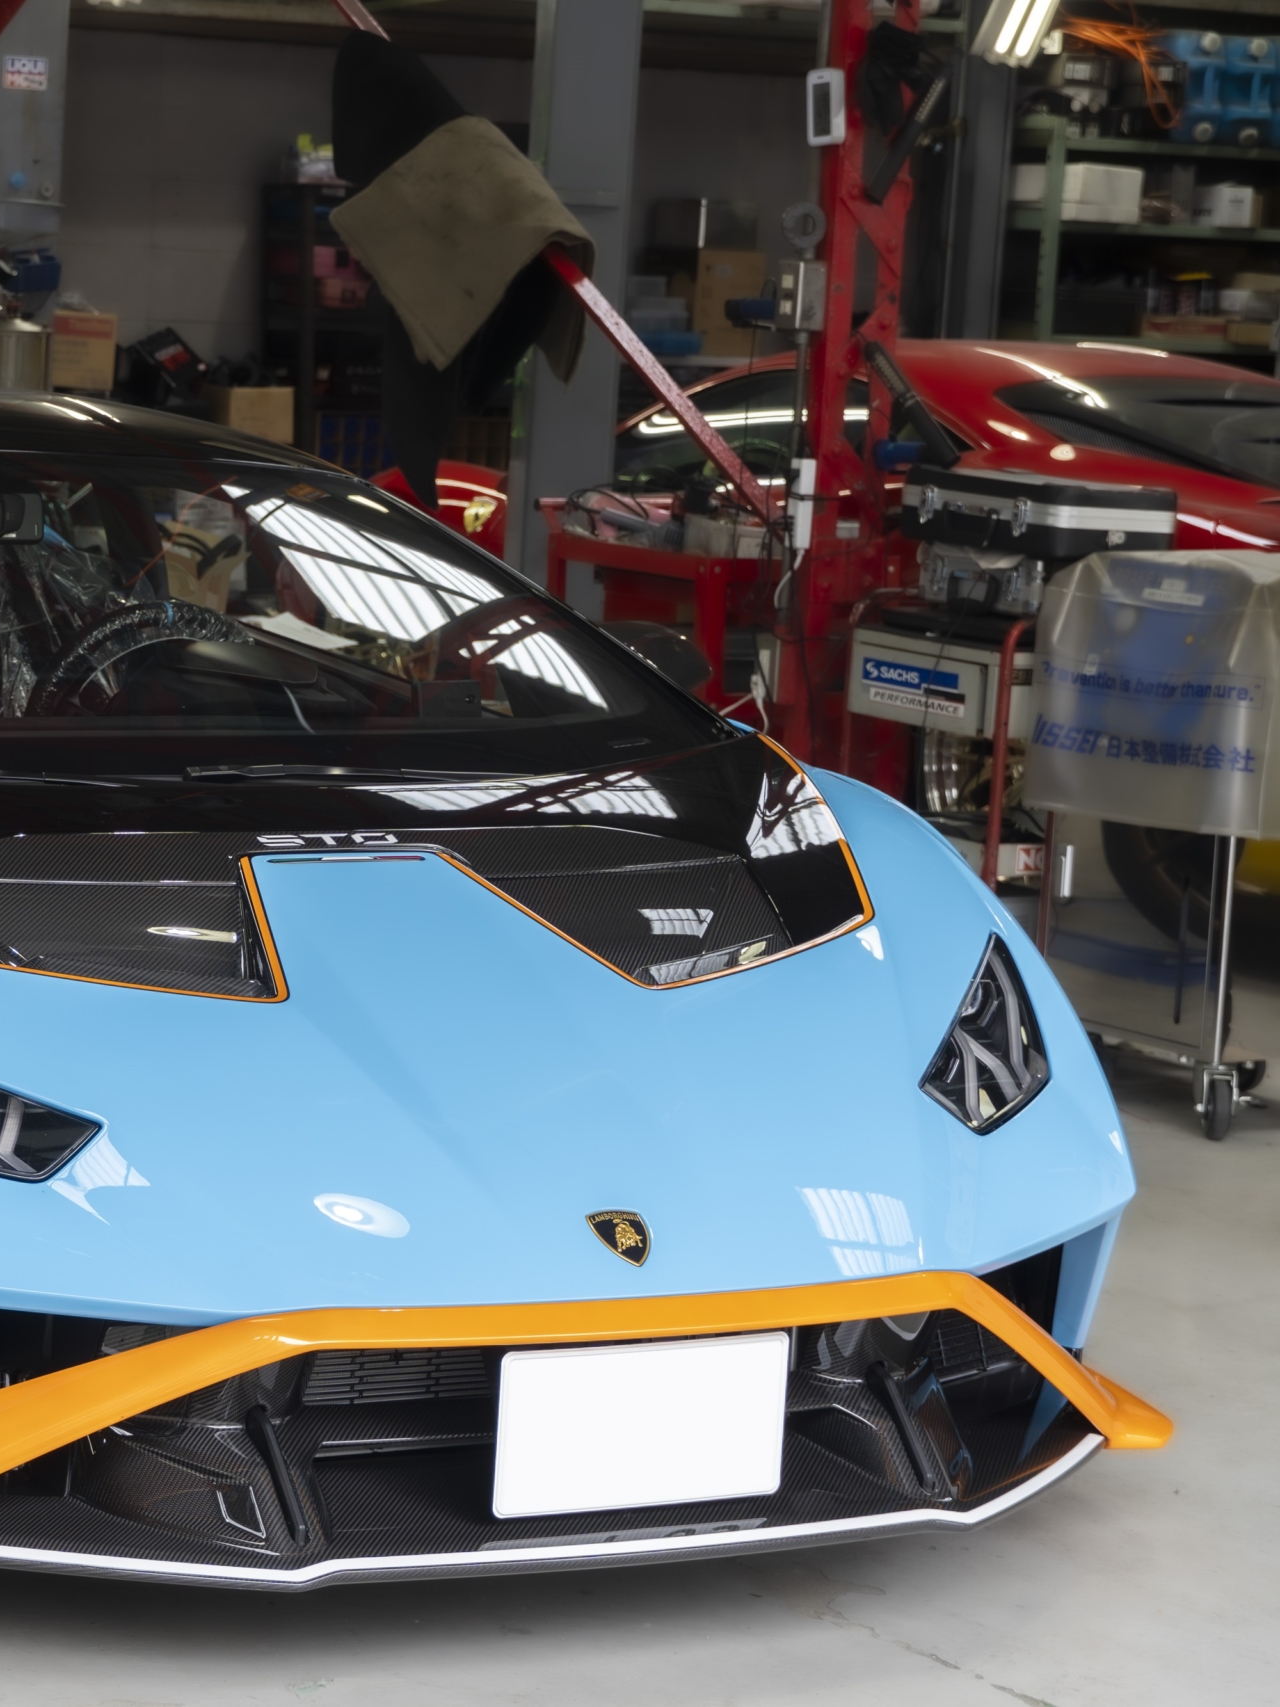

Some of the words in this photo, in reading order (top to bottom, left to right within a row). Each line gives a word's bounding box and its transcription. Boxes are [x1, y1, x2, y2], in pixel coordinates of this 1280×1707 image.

[6, 59, 46, 74] LIQUI
[880, 666, 920, 684] SACHS
[1119, 674, 1131, 692] is
[1180, 680, 1211, 698] than
[873, 691, 960, 715] PERFORMANCE
[1032, 713, 1101, 755] ISSEI
[256, 832, 399, 847] STO
[590, 1212, 640, 1224] LAMBORGHINI
